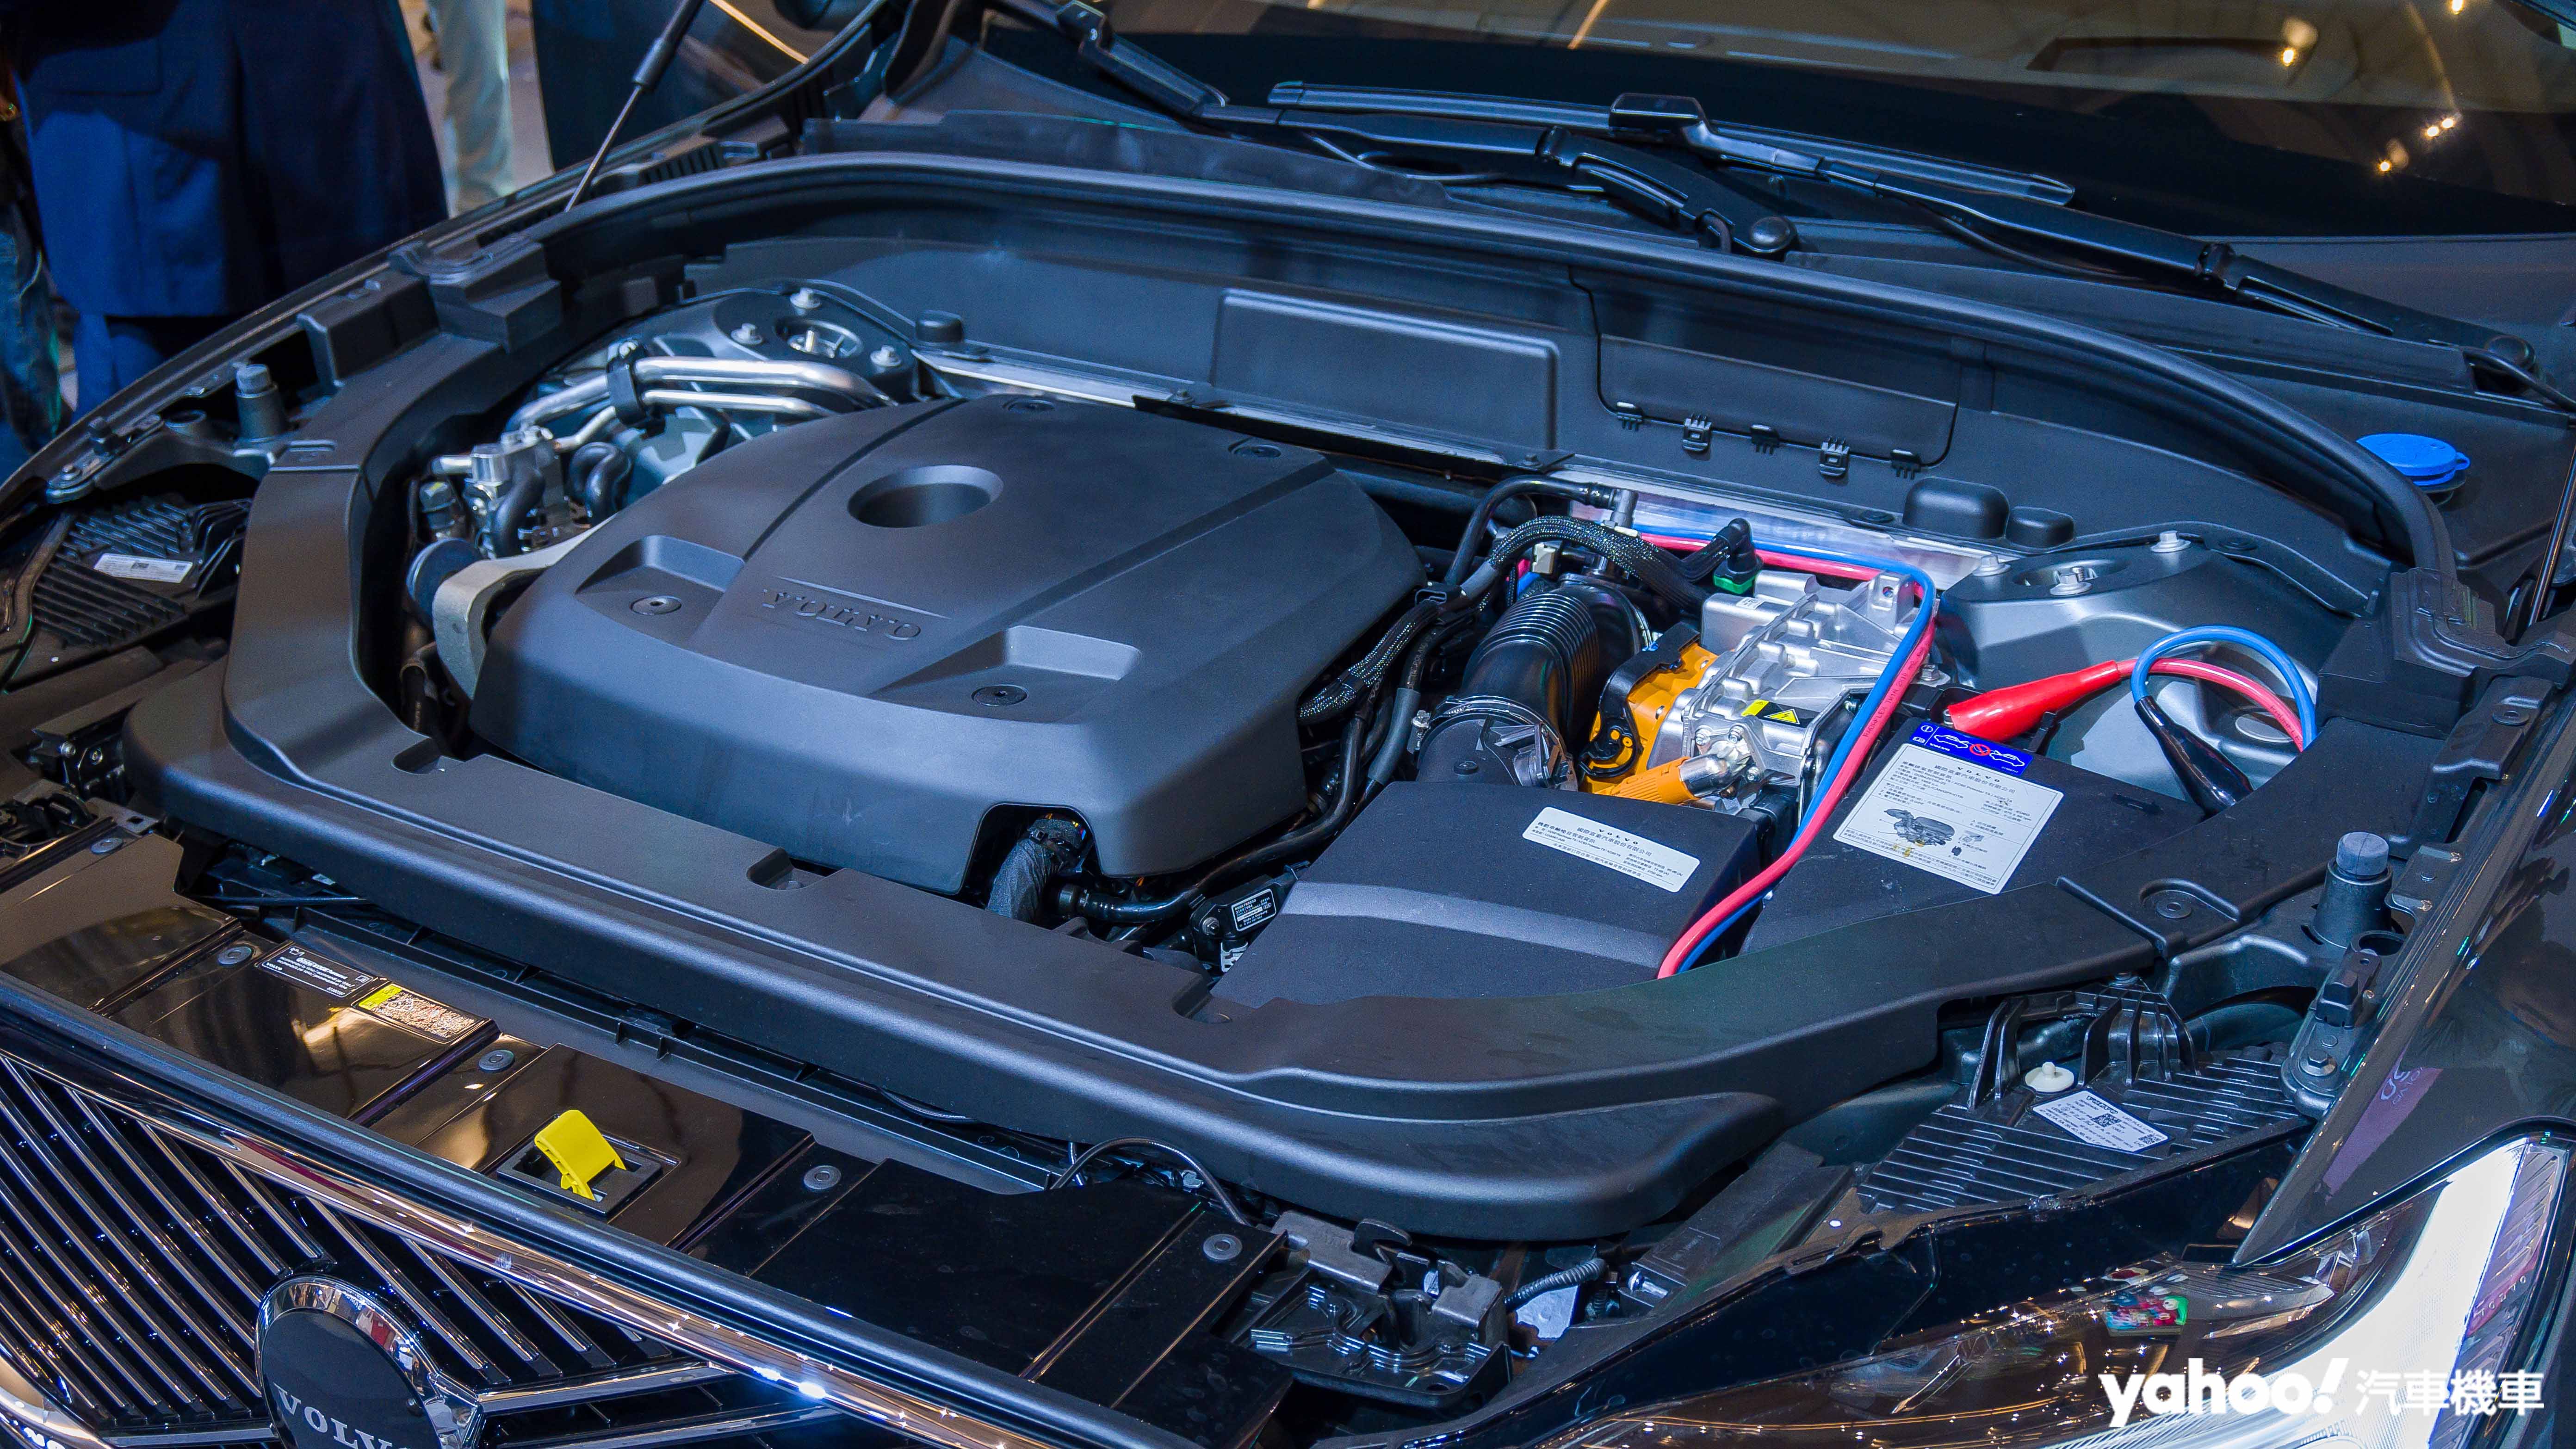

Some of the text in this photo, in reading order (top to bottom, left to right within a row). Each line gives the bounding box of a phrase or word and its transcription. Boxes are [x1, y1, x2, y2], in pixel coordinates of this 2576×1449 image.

[762, 588, 921, 641] VOLVO
[1929, 743, 1950, 751] VOLVO
[1957, 767, 2000, 782] VOLVO
[1599, 829, 1638, 845] VOLVO
[266, 962, 283, 971] VOLVO
[273, 1383, 412, 1449] VOLV
